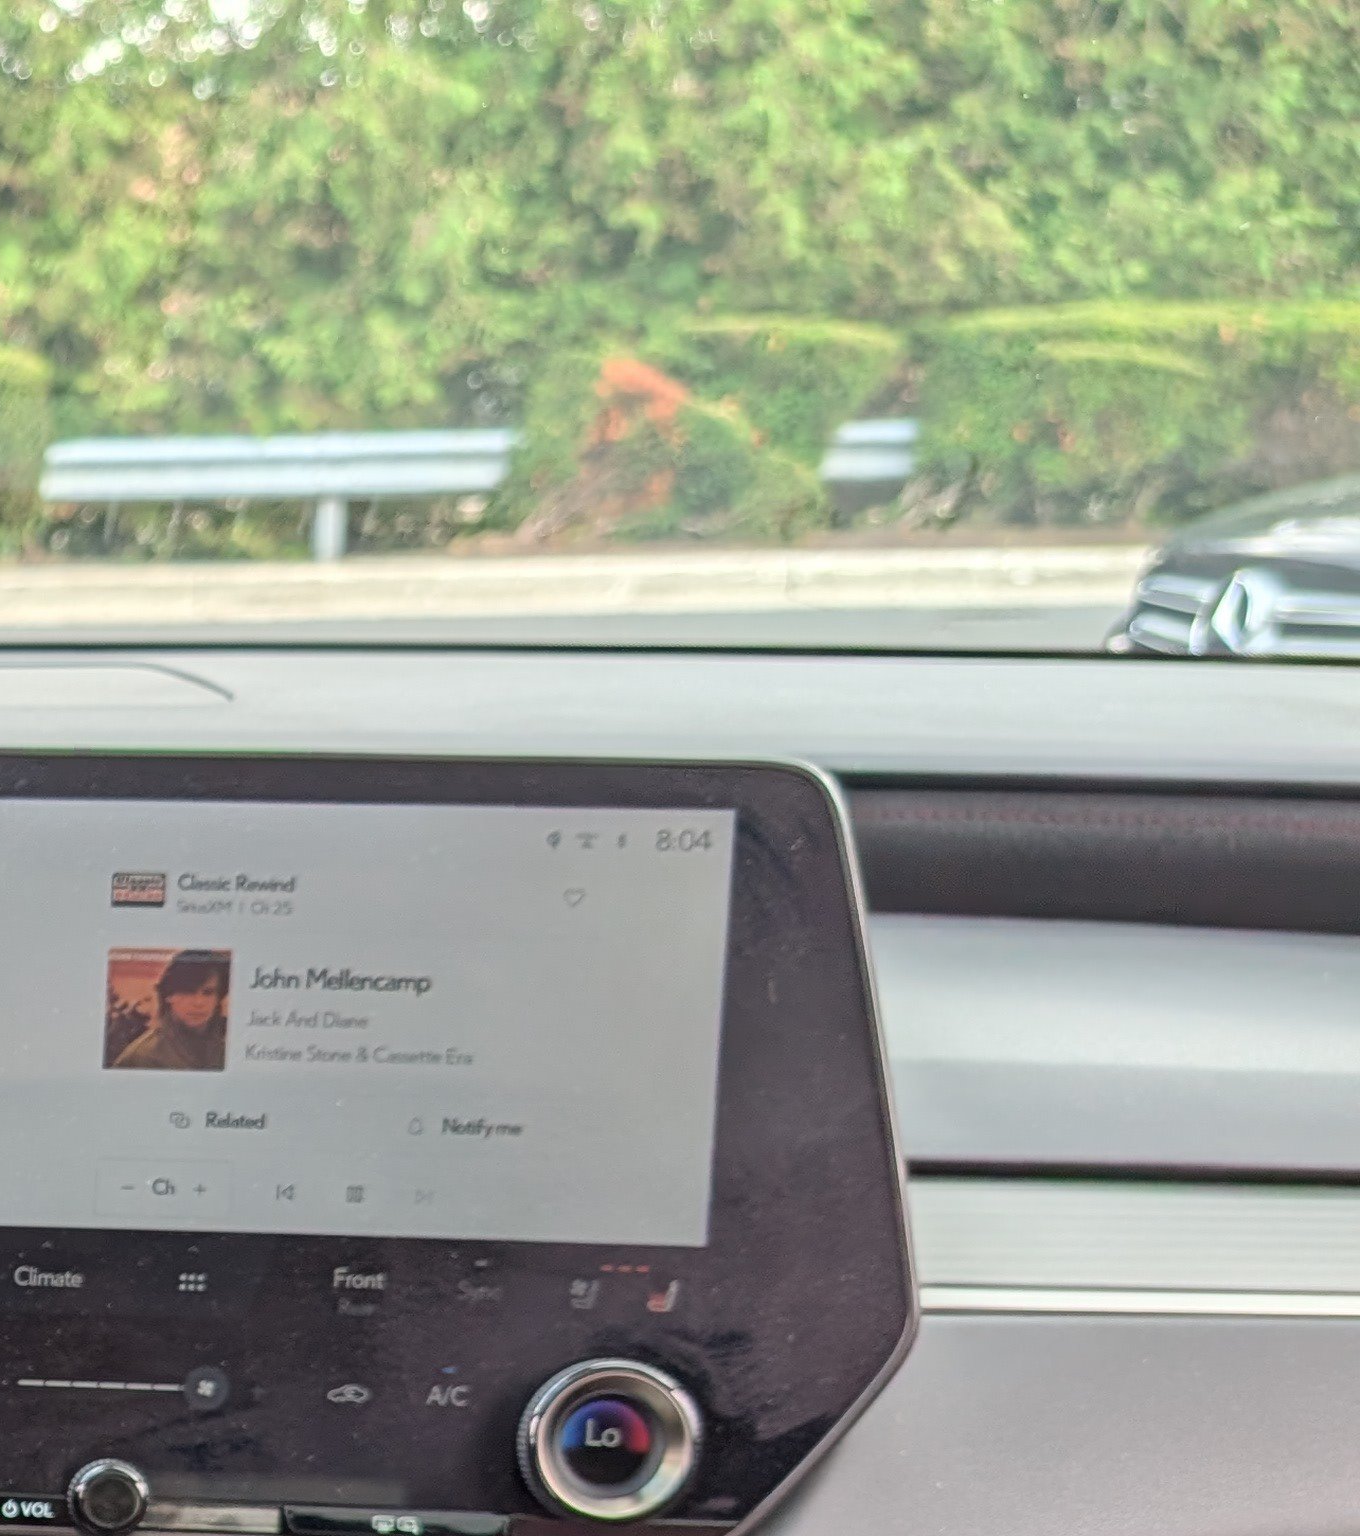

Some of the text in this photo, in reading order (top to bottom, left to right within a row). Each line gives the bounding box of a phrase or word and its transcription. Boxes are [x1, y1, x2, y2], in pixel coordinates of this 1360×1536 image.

[655, 829, 712, 851] 8:04
[249, 966, 432, 997] John Mellencamp
[205, 1111, 267, 1130] Related
[14, 1265, 84, 1290] Climate
[332, 1266, 387, 1291] Front
[425, 1384, 472, 1407] A/C
[585, 1420, 621, 1448] Lo
[20, 1501, 55, 1518] VOL
